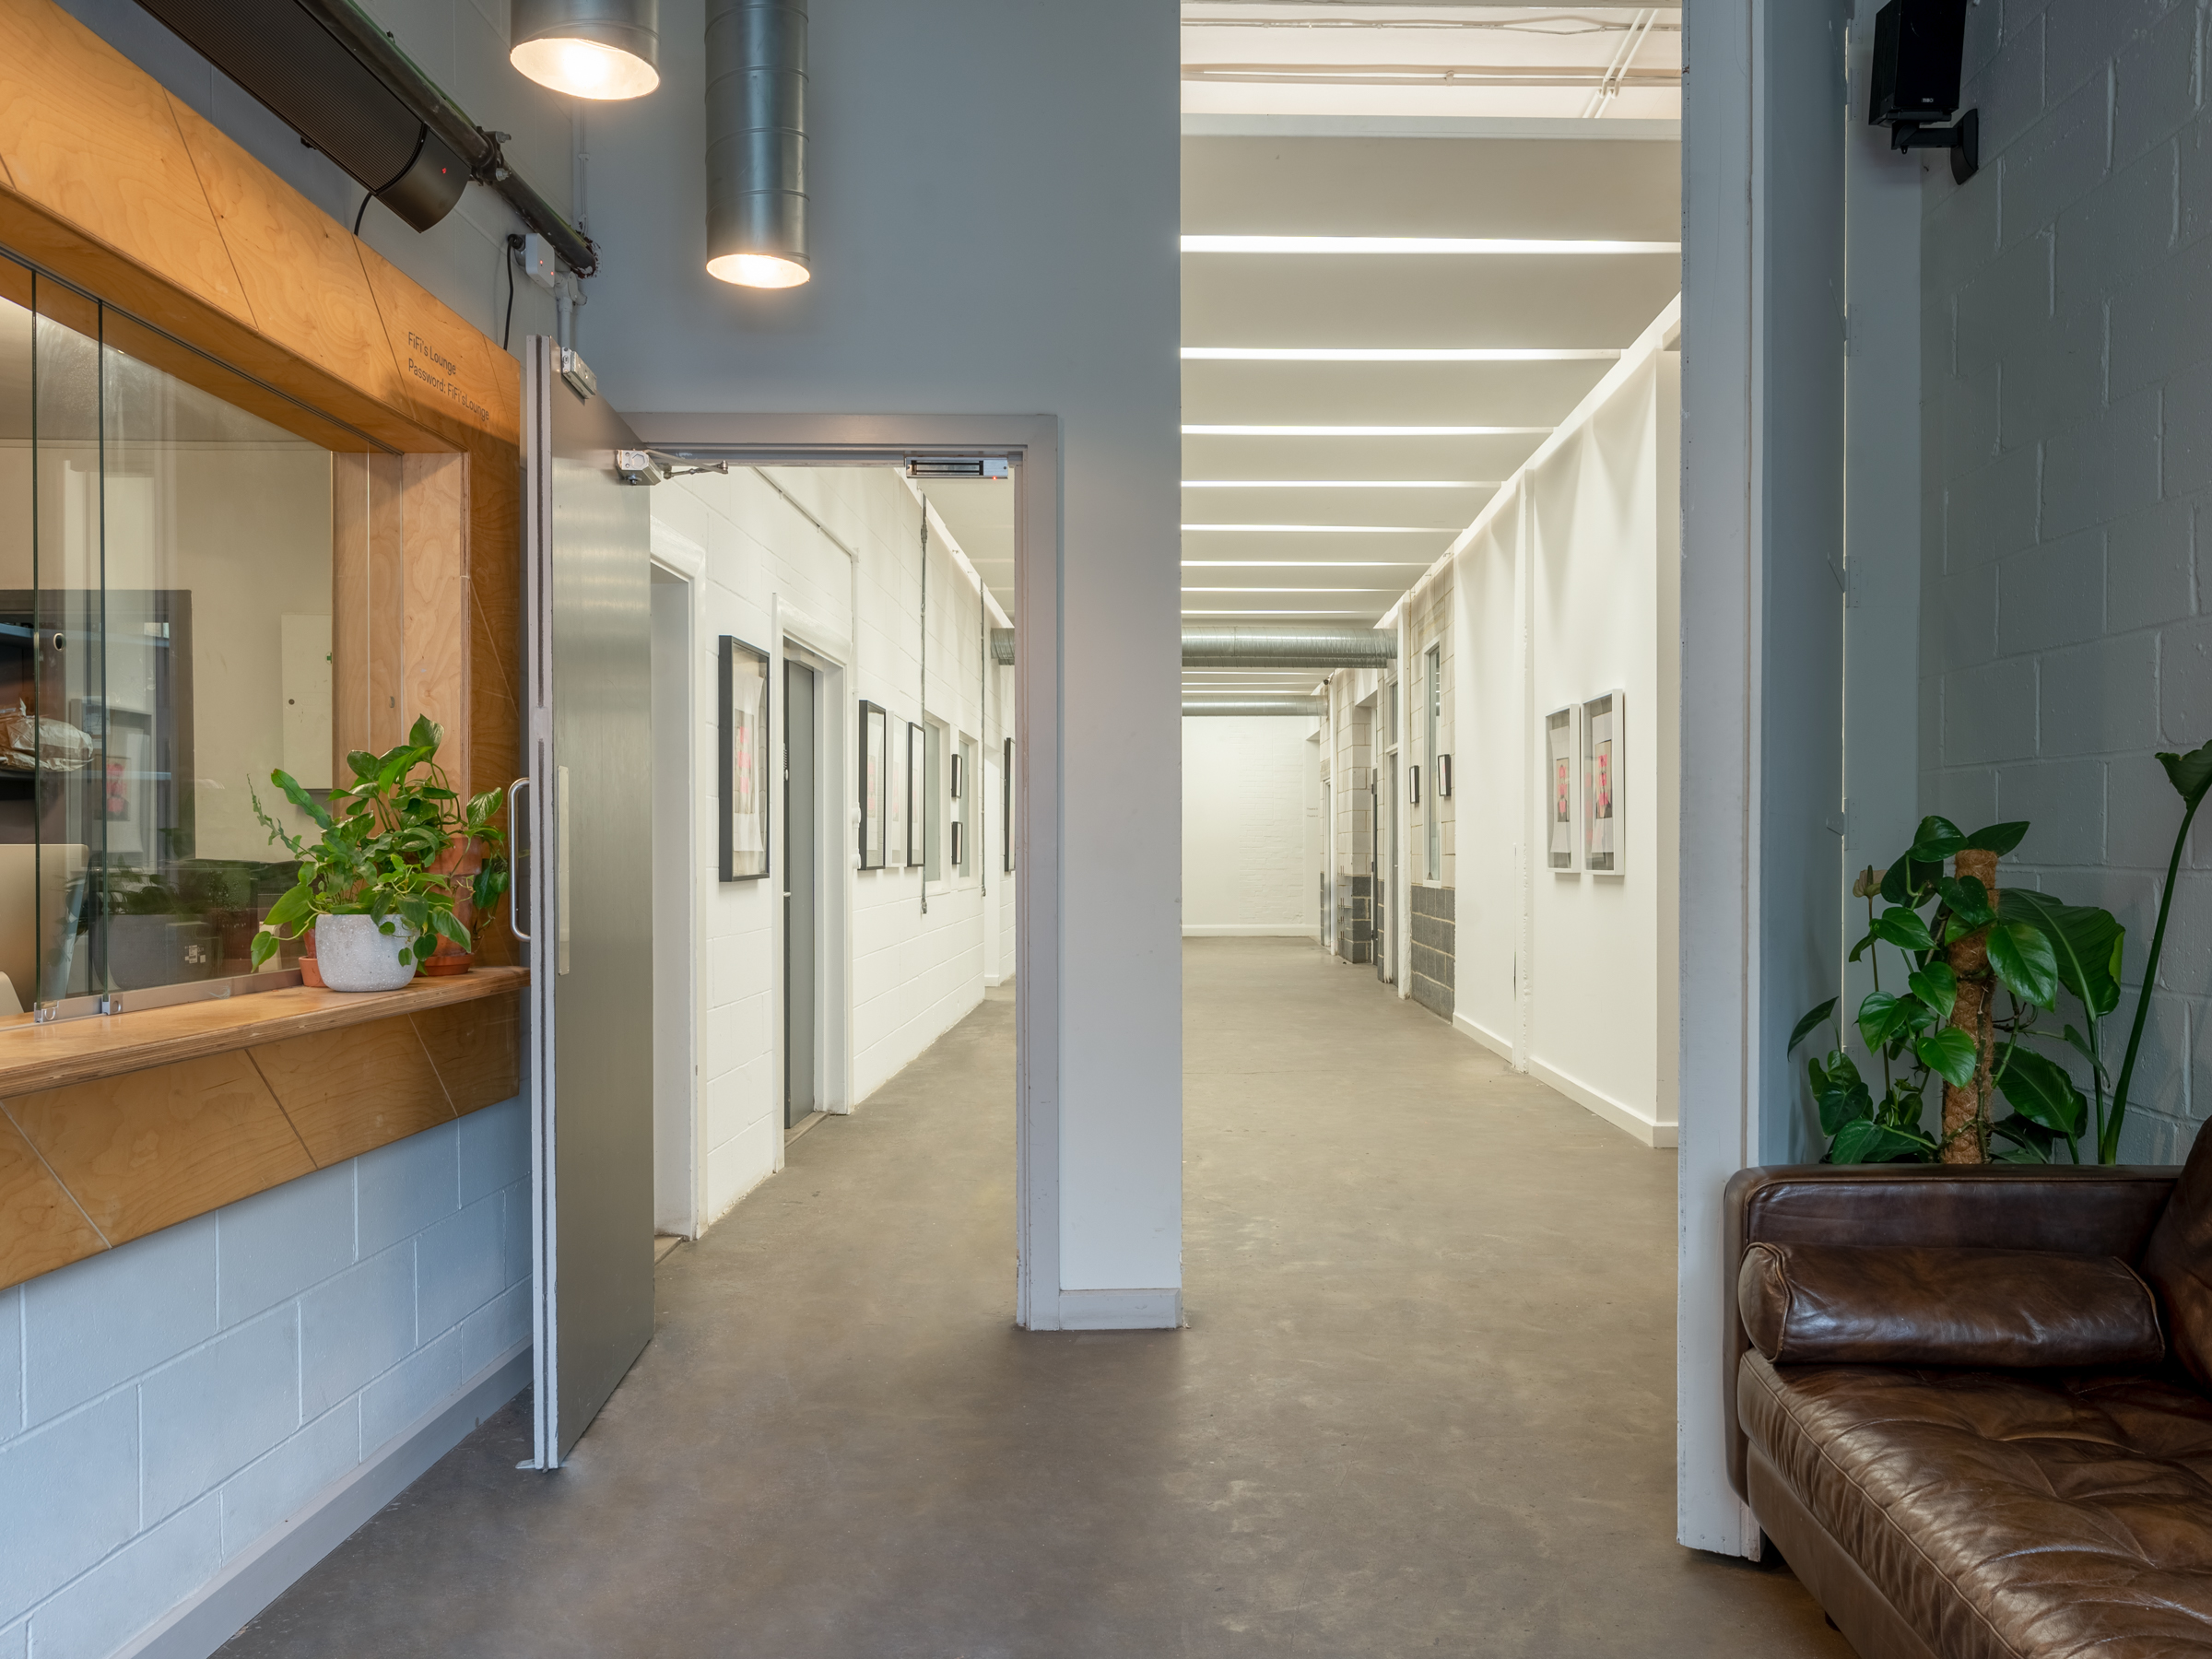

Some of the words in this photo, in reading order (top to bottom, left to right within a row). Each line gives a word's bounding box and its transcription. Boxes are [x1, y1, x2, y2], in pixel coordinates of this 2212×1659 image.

[408, 332, 429, 357] FiFi's
[429, 346, 456, 376] Lounge
[408, 358, 446, 394] Password:
